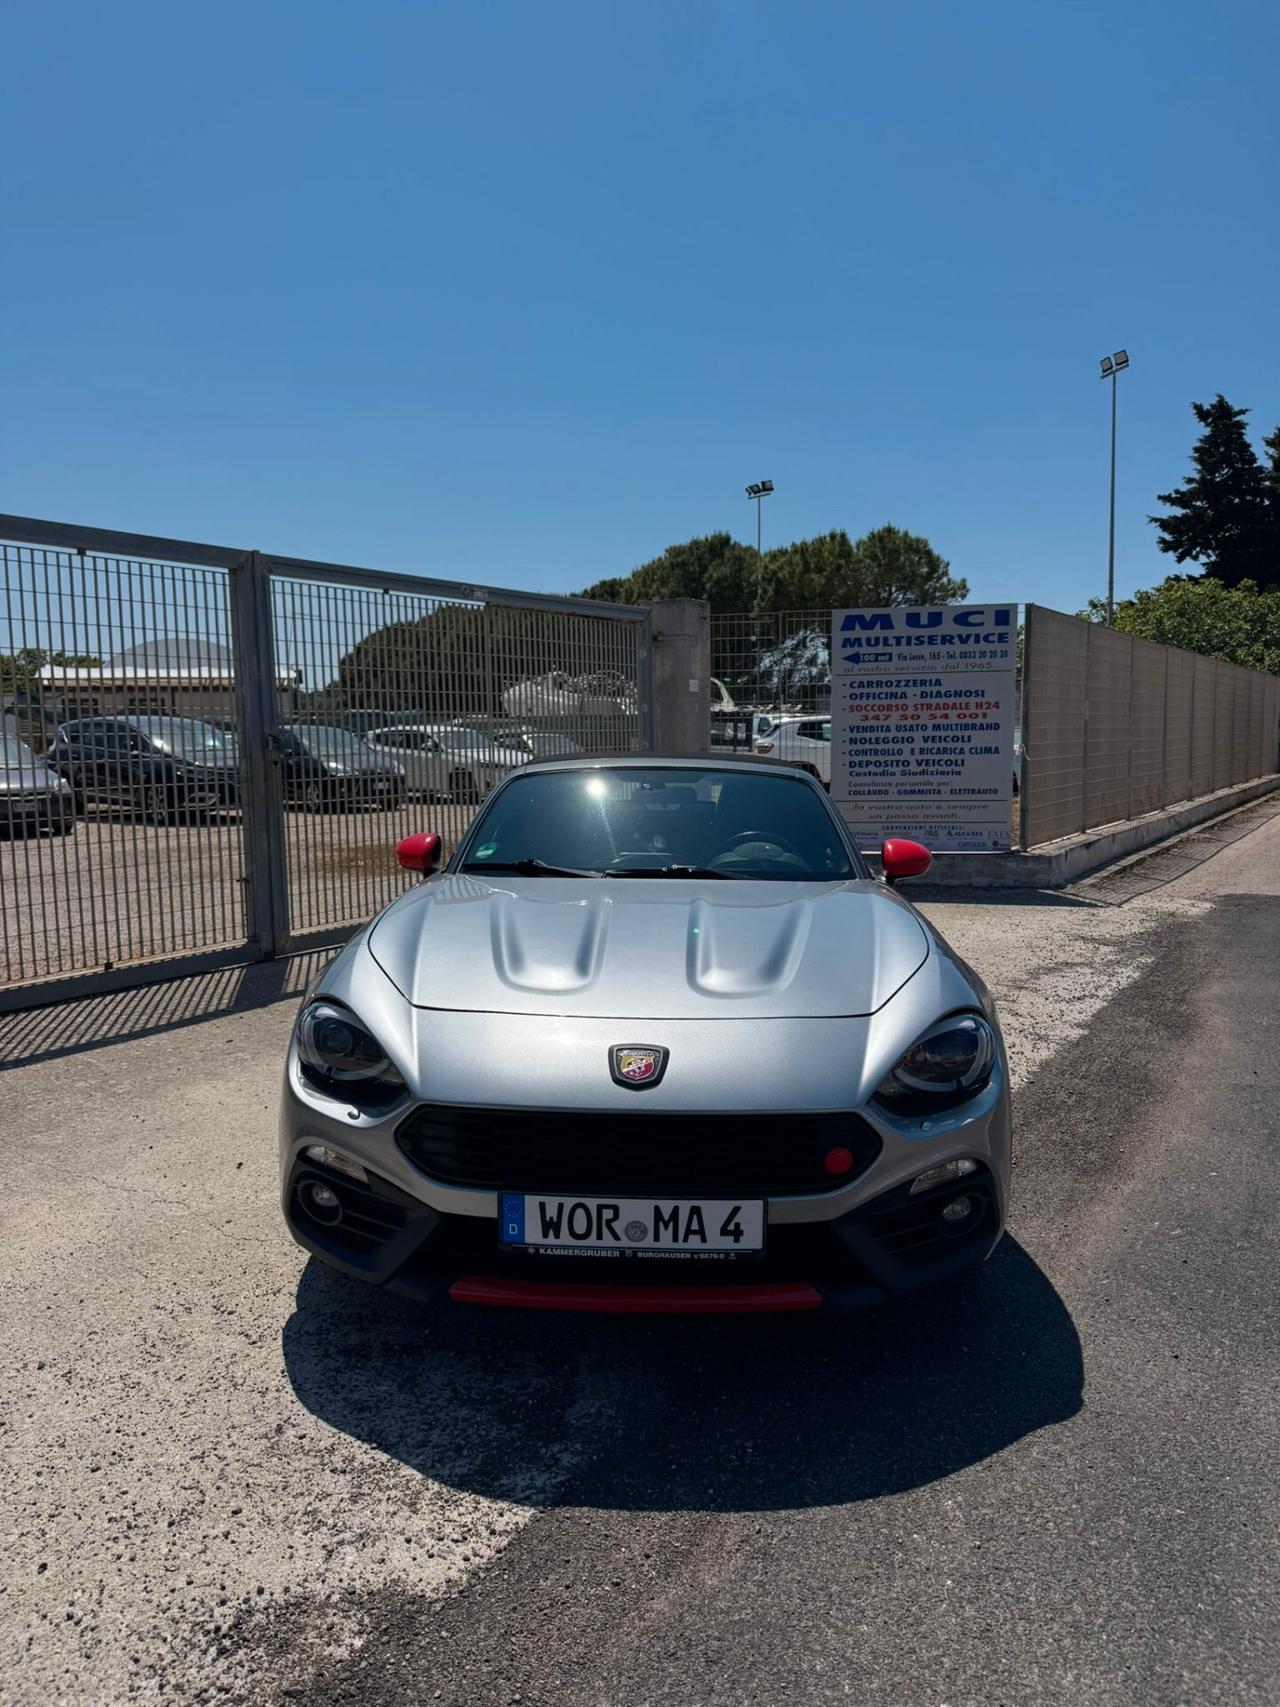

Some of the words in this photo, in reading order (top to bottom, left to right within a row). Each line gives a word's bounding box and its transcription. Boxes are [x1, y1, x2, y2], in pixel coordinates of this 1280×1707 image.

[840, 609, 1010, 631] MUCI
[841, 632, 1009, 648] MULTISERVICE
[859, 654, 876, 662] 100
[843, 665, 854, 673] al
[857, 664, 891, 673] vostro
[895, 663, 939, 672] servizio
[940, 662, 962, 671] dal
[849, 679, 942, 689] CARROZZERIA
[849, 691, 908, 701] OFFICINA
[920, 689, 985, 699] DIAGNOSI
[848, 703, 909, 713] SOCCORSO
[913, 702, 971, 712] STRADALE
[975, 701, 1000, 710] H24
[860, 714, 892, 722] 347
[899, 713, 921, 721] 50
[956, 712, 988, 720] 001
[848, 724, 891, 734] VENDITA
[895, 723, 928, 733] USATO
[931, 722, 1000, 732] MULTIBRAND
[848, 736, 915, 745] NOLEGGIO
[921, 735, 971, 744] VEICOLI
[848, 748, 903, 757] CONTROLLO
[919, 747, 965, 756] RICARICA
[968, 746, 1000, 755] CLIMA
[848, 759, 910, 769] DEPOSITO
[915, 758, 965, 768] VEICOLI
[900, 768, 962, 777] Giudiziaria
[848, 788, 889, 796] COLLAUDO
[896, 788, 942, 796] GOMMISTA
[950, 787, 999, 795] ELETTRAUTO
[947, 804, 989, 812] sempre
[538, 1201, 622, 1241] WOR
[653, 1205, 707, 1243] MA
[720, 1205, 744, 1243] 4
[508, 1223, 518, 1235] D
[539, 1247, 620, 1259] KAMMERGRUBER
[637, 1251, 691, 1260] BURGHAUSEN
